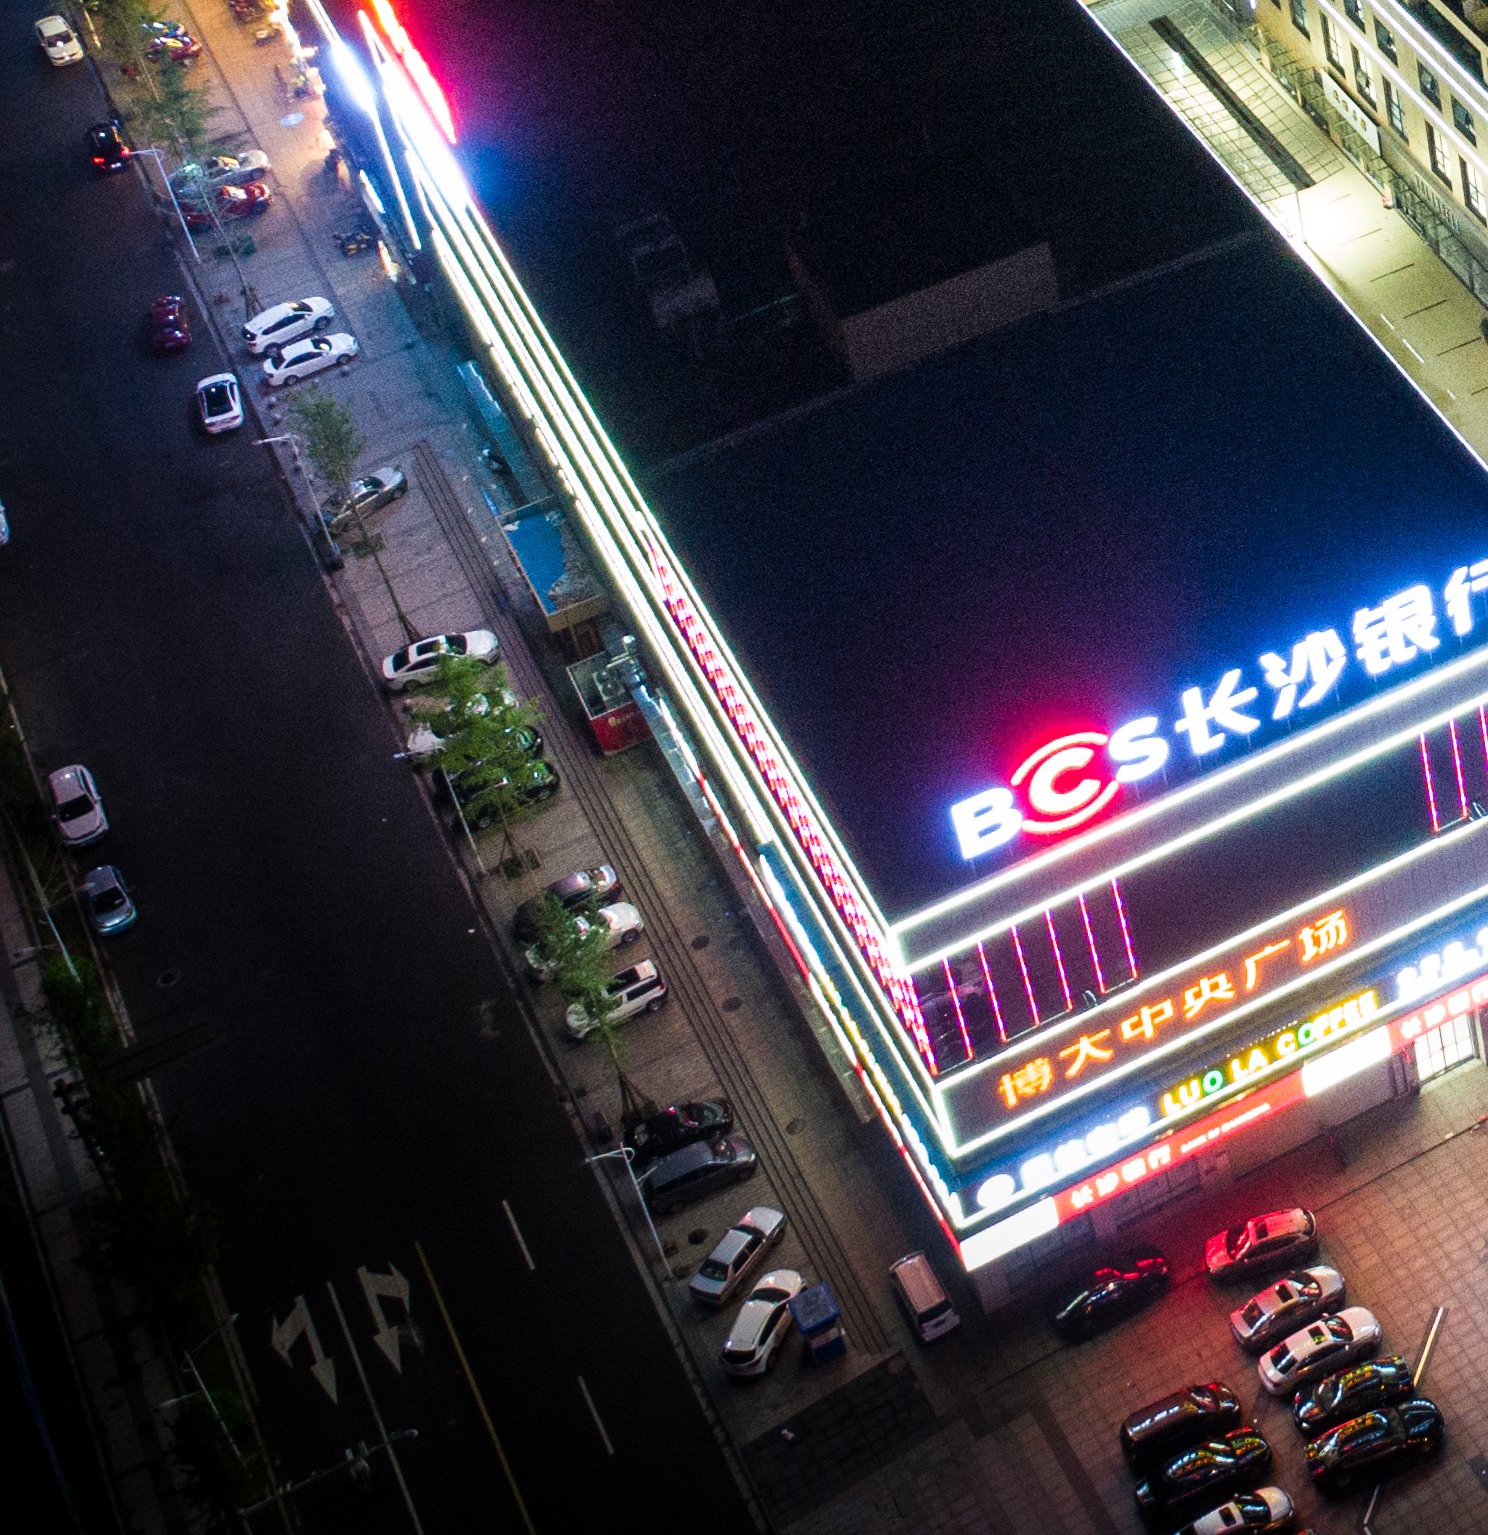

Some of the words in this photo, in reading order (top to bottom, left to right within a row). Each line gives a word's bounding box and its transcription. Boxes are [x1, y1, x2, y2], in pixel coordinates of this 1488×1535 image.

[950, 717, 1170, 861] BCS
[998, 908, 1348, 1108] 博大中央广场
[1163, 1069, 1224, 1115] LUO
[1231, 1048, 1268, 1080] LA
[1276, 990, 1378, 1057] COFFEE
